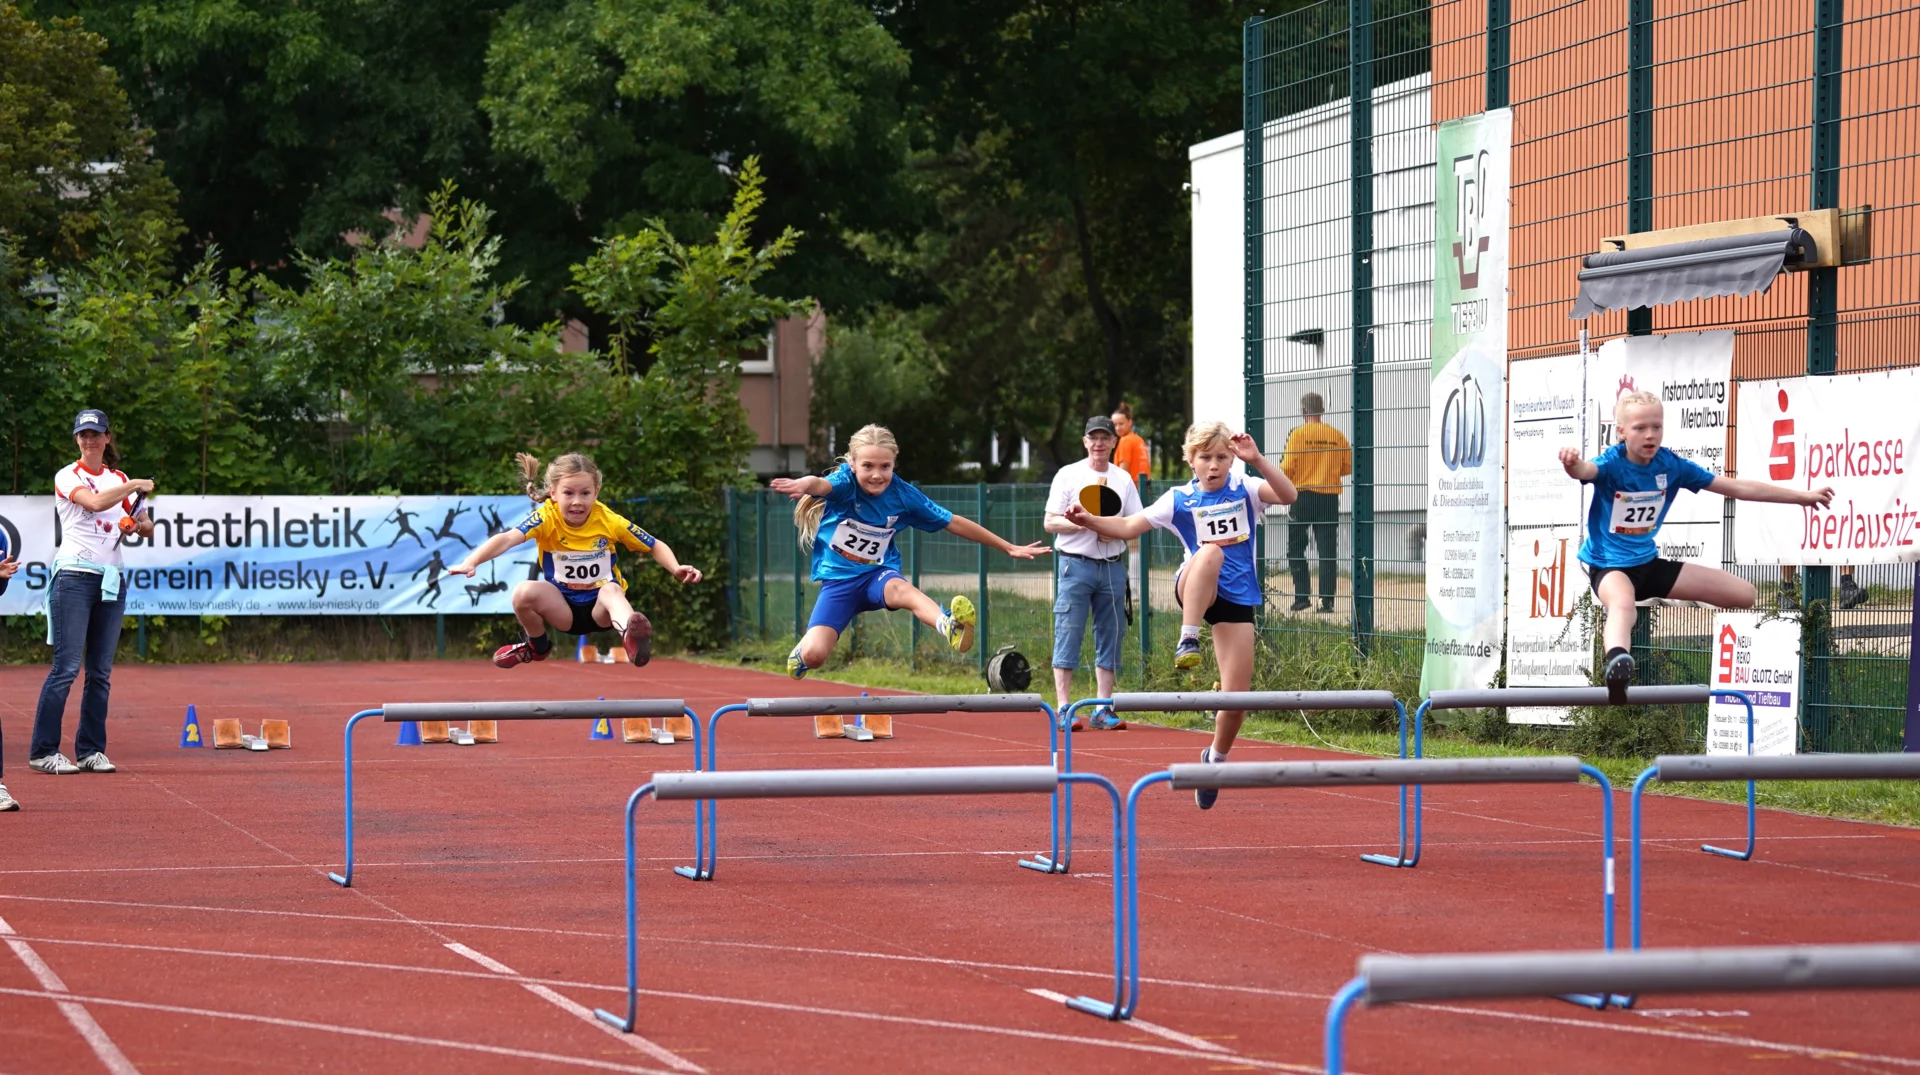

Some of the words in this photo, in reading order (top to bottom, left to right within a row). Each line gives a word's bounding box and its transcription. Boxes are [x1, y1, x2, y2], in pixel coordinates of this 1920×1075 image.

[1662, 378, 1725, 404] Instandhaltung
[1681, 406, 1725, 429] Metallbau
[1803, 428, 1904, 490] parkasse
[1438, 477, 1453, 491] Otto
[1432, 495, 1438, 507] &
[1624, 506, 1656, 523] 272
[1207, 517, 1238, 536] 151
[844, 534, 880, 555] 273
[1662, 542, 1700, 561] Waggonbau
[1700, 542, 1705, 557] 7
[224, 561, 330, 598] Niesky
[340, 561, 395, 590] e.V.
[564, 564, 600, 579] 200
[158, 599, 260, 612] www.lsv-niesky.de
[277, 599, 380, 612] www.lsv-niesky.de
[1737, 635, 1749, 648] NEU
[1736, 651, 1751, 664] REKO
[1735, 666, 1750, 684] BAU
[1752, 669, 1772, 683] GLOTZ
[1773, 669, 1793, 684] GmbH
[1758, 692, 1781, 706] Tiefbau
[186, 723, 199, 742] 2
[596, 718, 609, 735] 4
